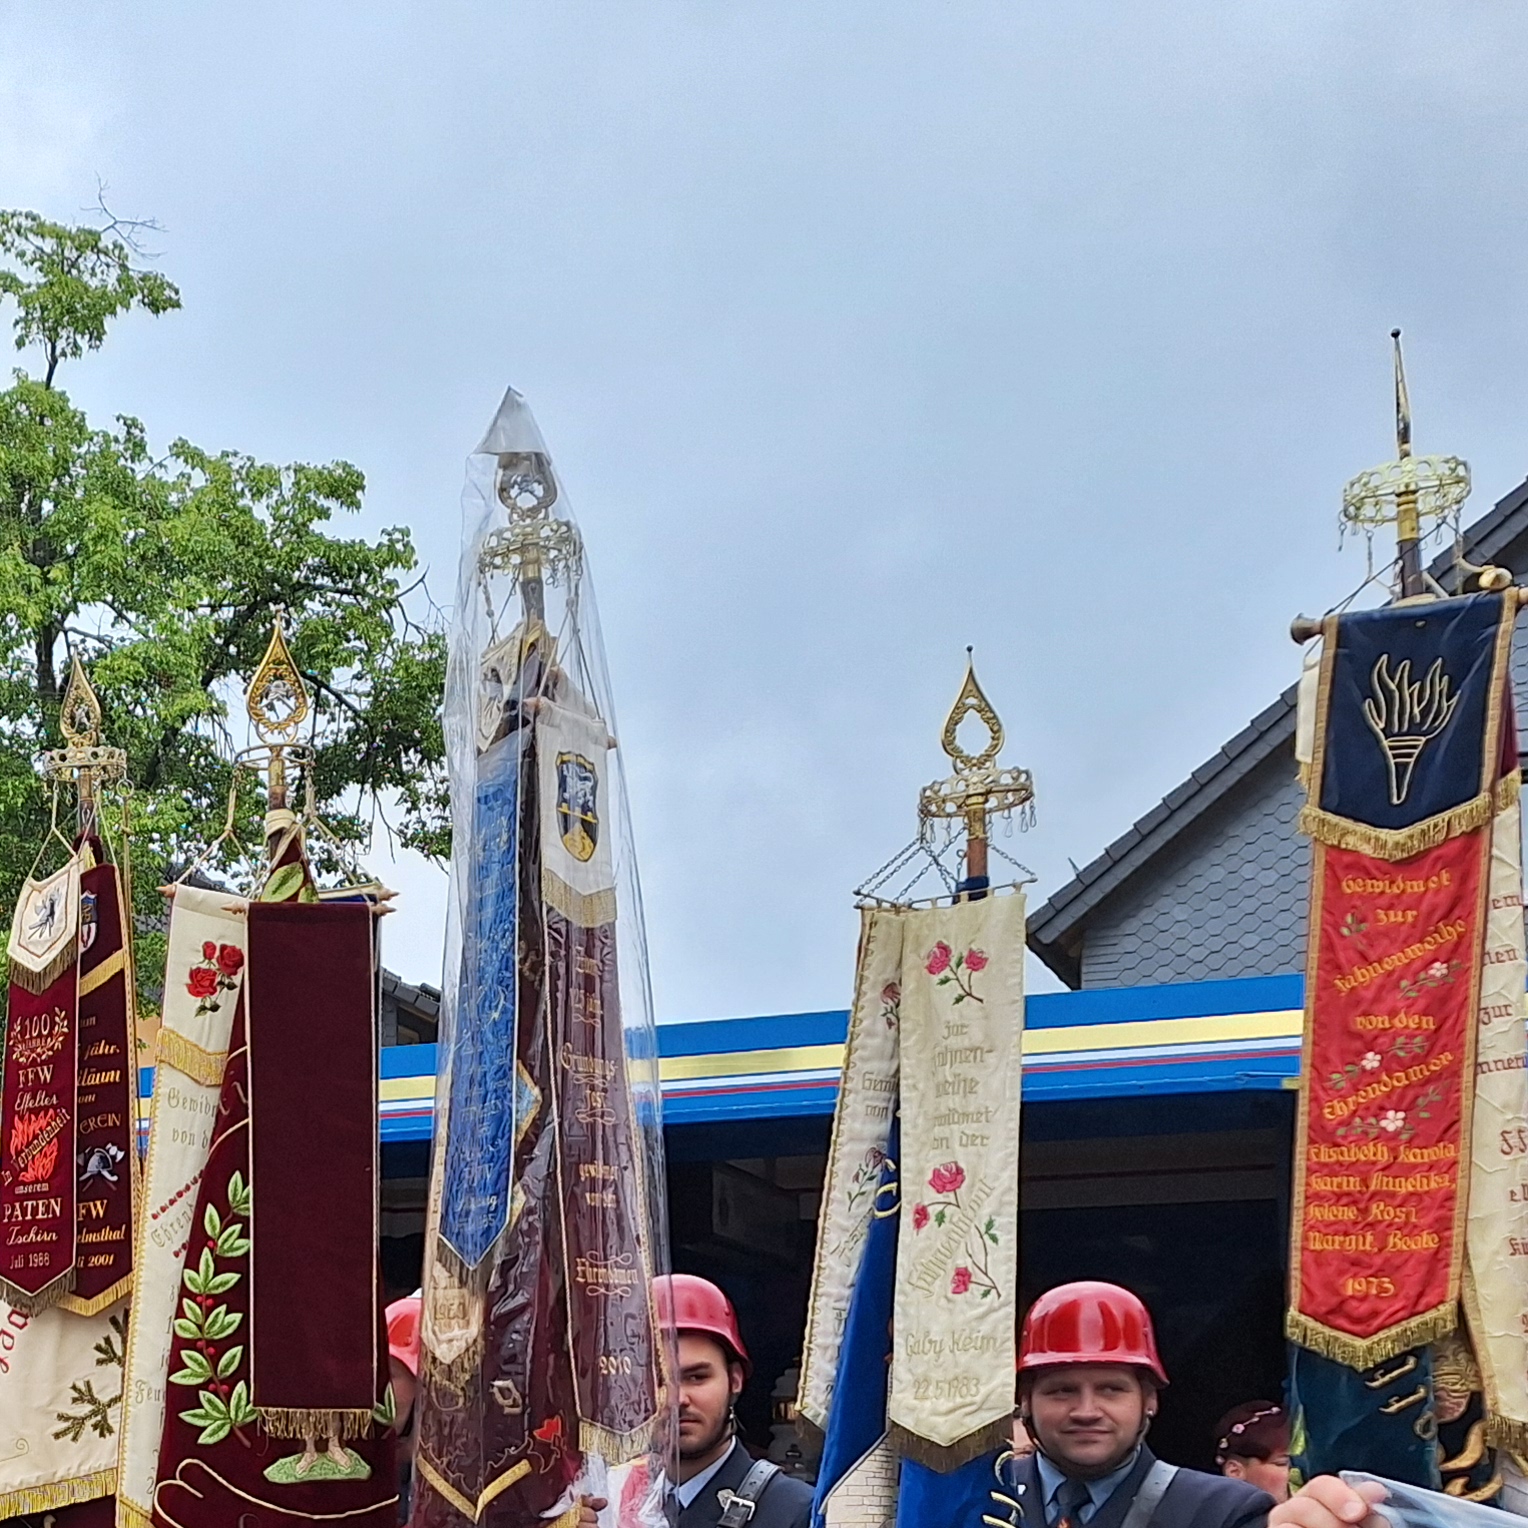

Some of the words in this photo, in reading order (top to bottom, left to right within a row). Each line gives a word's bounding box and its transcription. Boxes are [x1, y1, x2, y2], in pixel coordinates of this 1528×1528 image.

[1340, 869, 1451, 895] Gewidmet
[1375, 908, 1418, 925] zur
[24, 1013, 51, 1040] 100
[1354, 1014, 1390, 1030] von
[1392, 1009, 1437, 1030] den
[18, 1063, 54, 1088] FFW
[10, 1106, 72, 1172] Verbundenheit
[2, 1197, 62, 1224] PATEN
[1386, 1229, 1440, 1252] Beate
[598, 1355, 632, 1377] 2010
